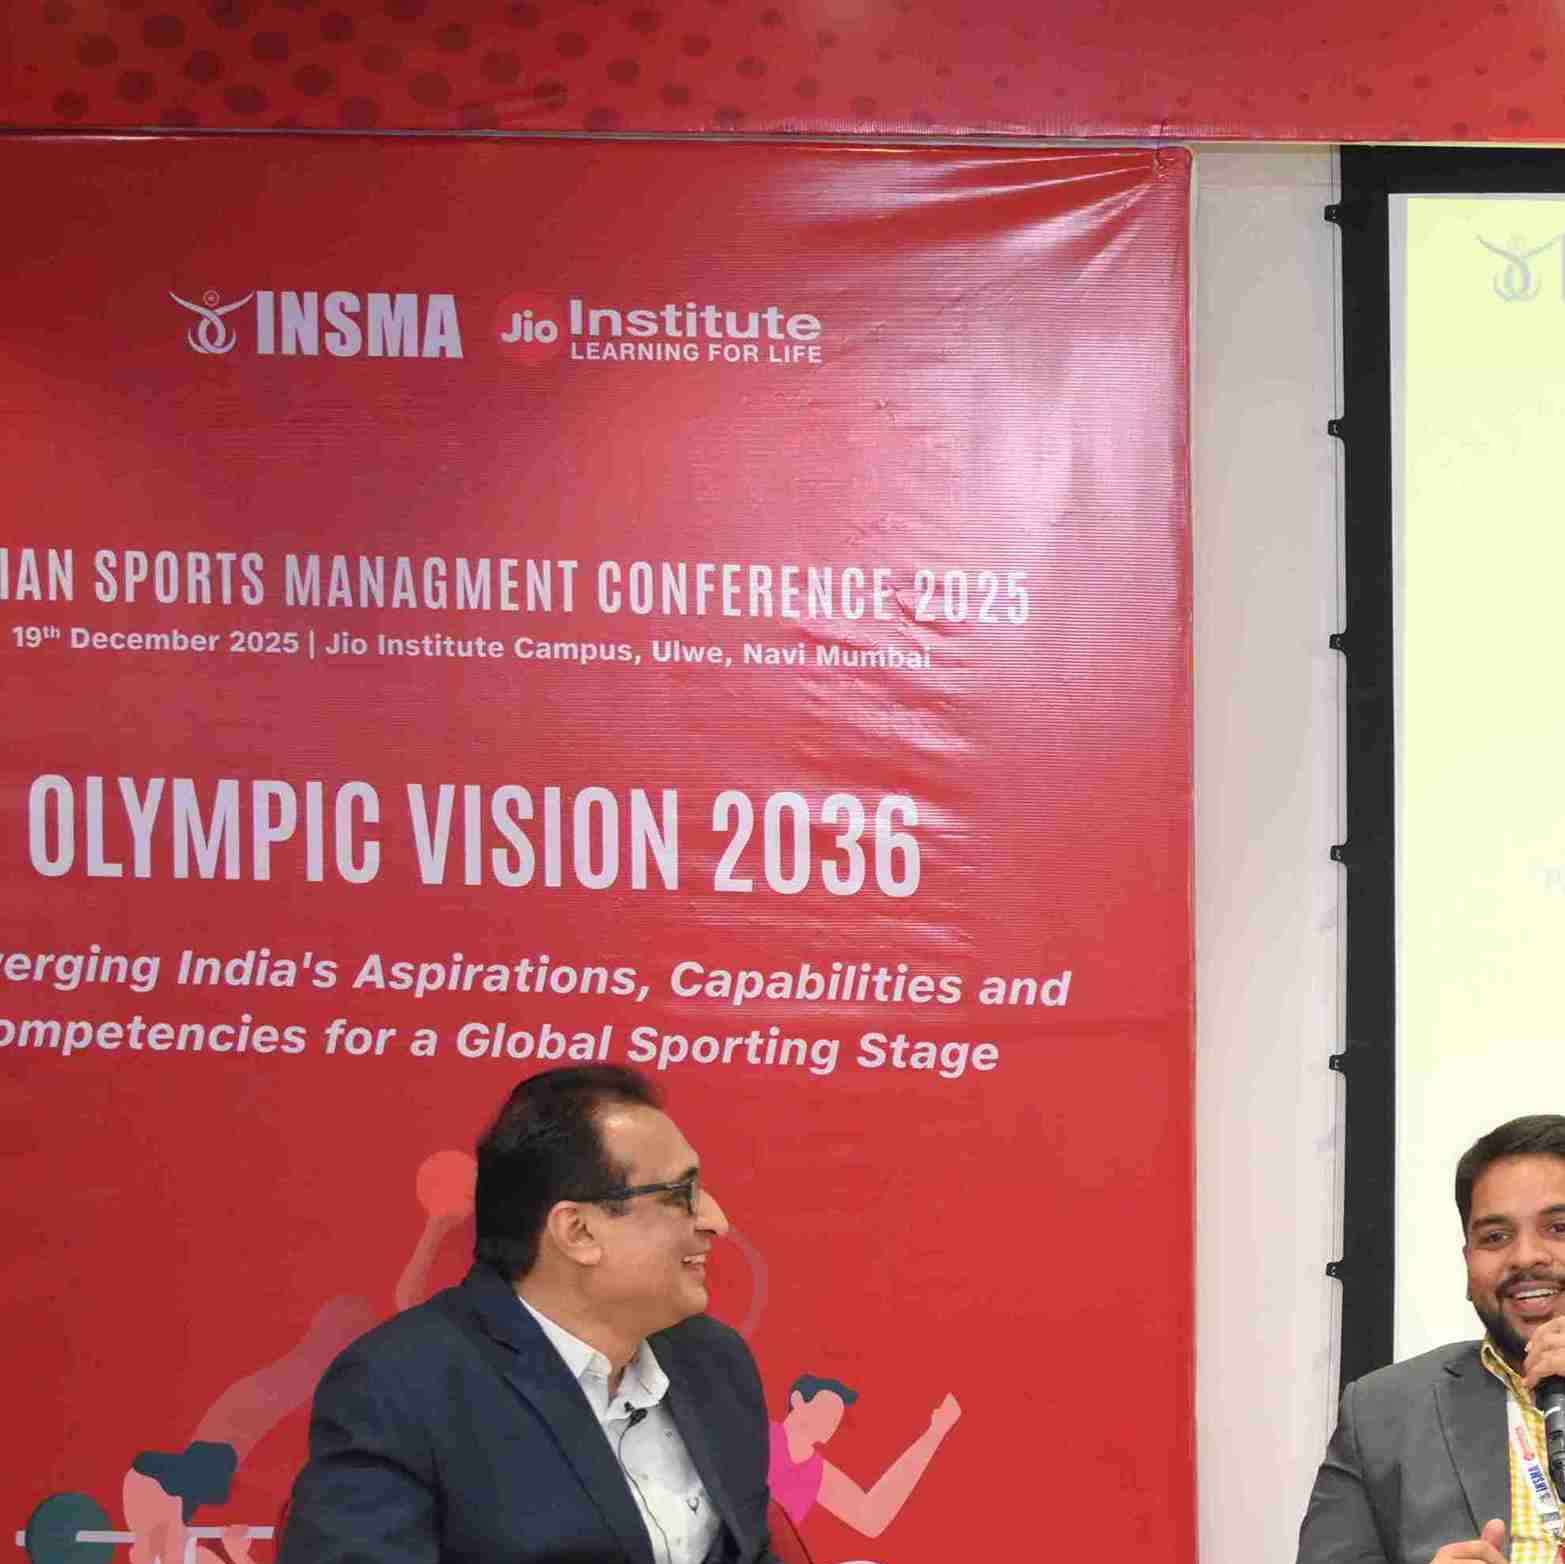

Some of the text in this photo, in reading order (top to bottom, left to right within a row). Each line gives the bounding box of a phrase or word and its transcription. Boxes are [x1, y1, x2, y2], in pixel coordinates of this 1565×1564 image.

[256, 290, 464, 359] INSMA
[501, 299, 822, 344] Jio Institute
[570, 341, 823, 364] LEARNING FOR LIFE
[94, 549, 266, 606] SPORTS
[284, 553, 579, 612] MANAGMENT
[599, 559, 894, 623] CONFERENCE
[914, 568, 1031, 625] 2025
[13, 625, 62, 648] 19th
[70, 627, 220, 654] December
[230, 631, 300, 655] 2025
[325, 631, 369, 657] Jio
[377, 634, 505, 659] Institute
[514, 637, 643, 666] Campus,
[652, 640, 733, 667] Ulwe,
[743, 642, 806, 667] Navi
[816, 645, 932, 670] Mumbai
[28, 773, 922, 898] OLYMPIC VISION 2036
[0, 944, 1073, 1008] erging India's Aspirations, Capabilities and
[325, 1016, 399, 1057] for
[409, 1028, 439, 1057] a
[456, 1023, 614, 1062] Global
[626, 1025, 840, 1075] Sporting
[856, 1032, 999, 1079] Stage
